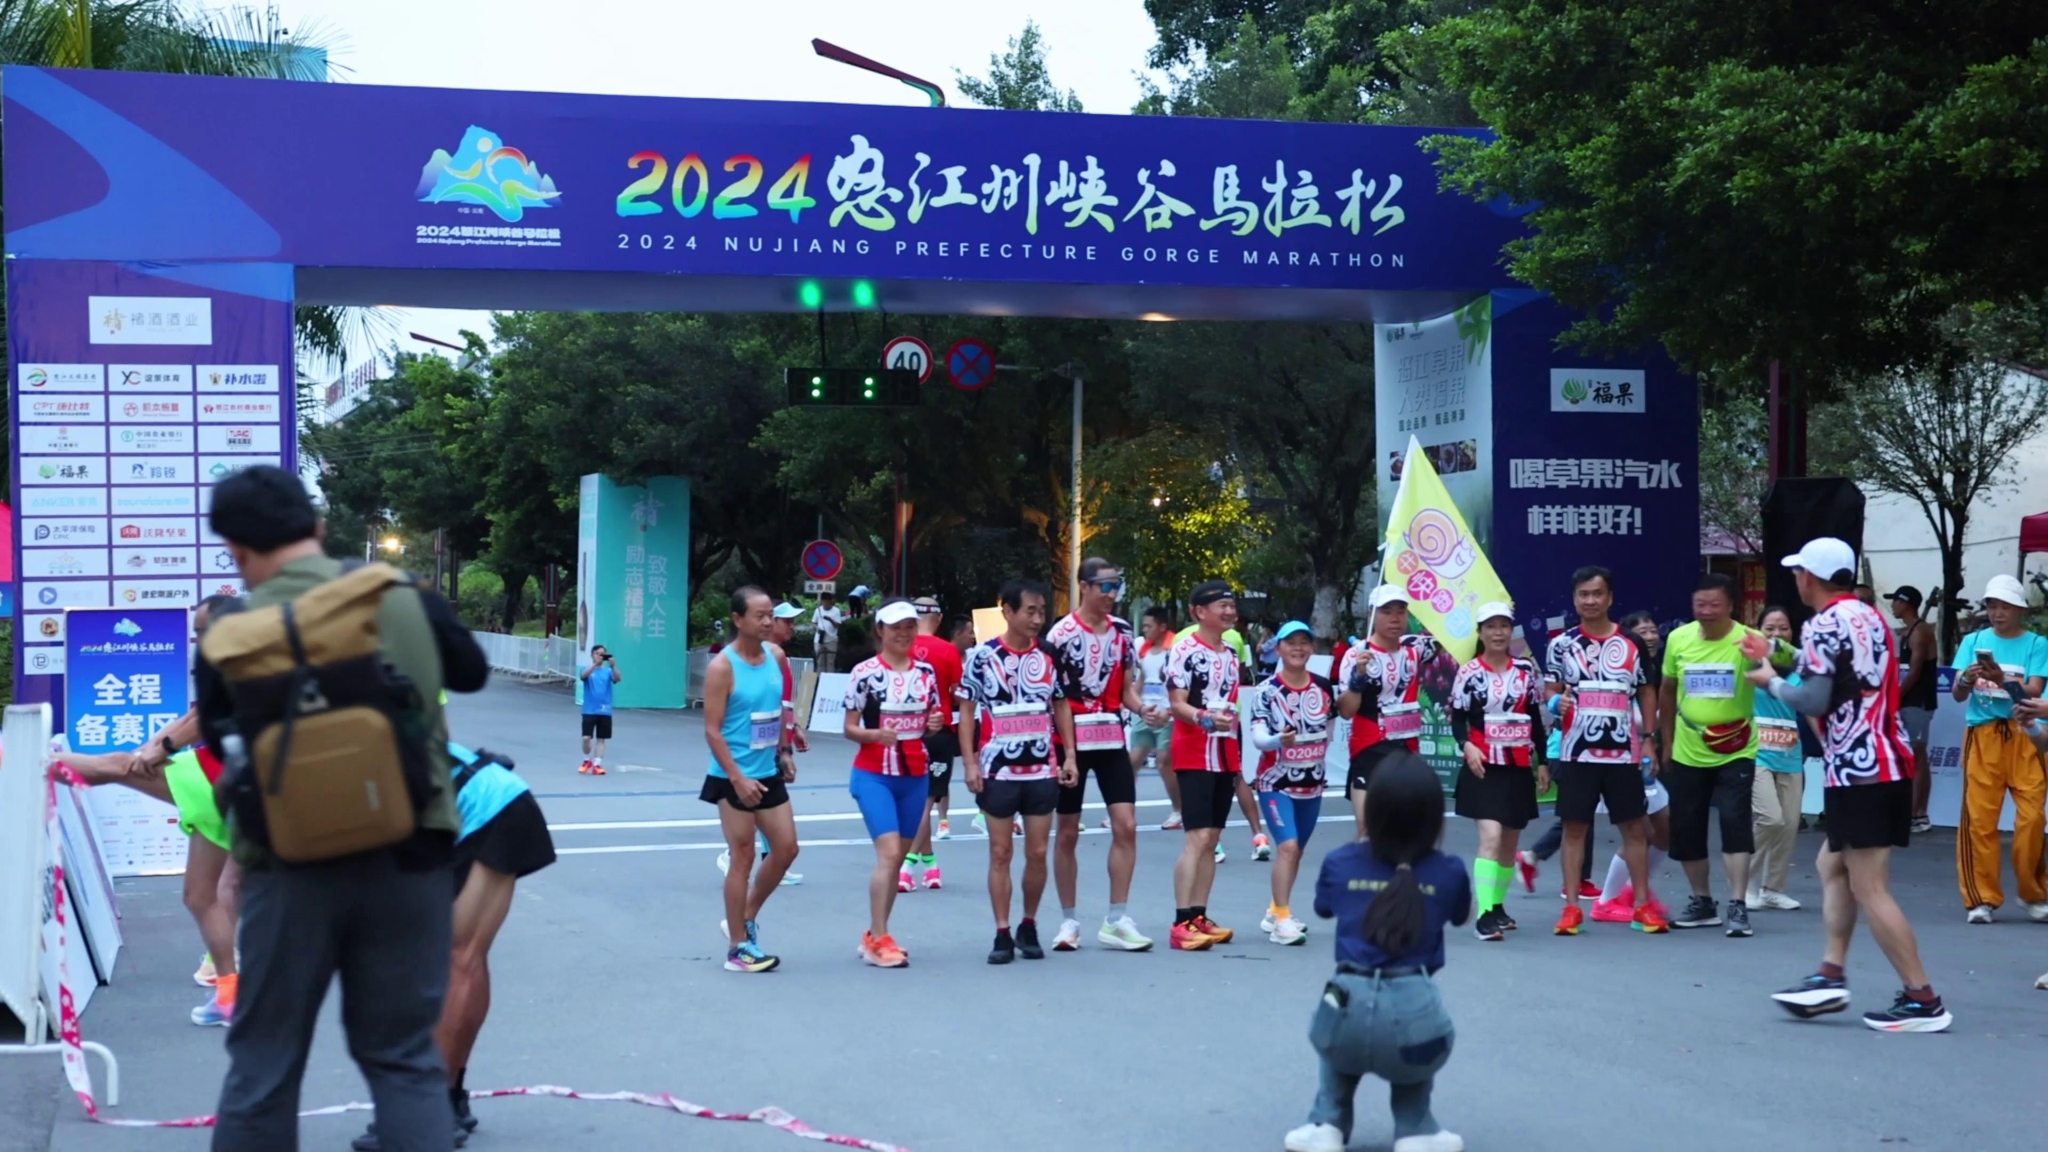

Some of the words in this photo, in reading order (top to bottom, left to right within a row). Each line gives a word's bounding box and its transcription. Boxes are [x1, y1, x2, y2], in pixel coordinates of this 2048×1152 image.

[618, 234, 698, 250] 2024
[724, 236, 870, 255] NUJIANG
[896, 241, 1098, 261] PREFECTURE
[1121, 247, 1220, 264] GORGE
[1243, 250, 1405, 267] MARATHON
[892, 351, 921, 373] 40
[1592, 381, 1635, 406] 福果
[60, 464, 89, 479] 福果
[1509, 458, 1683, 488] 喝草果汽水
[647, 555, 667, 637] 致敬人生
[93, 673, 162, 706] 全程
[1690, 677, 1728, 689] B1461
[1001, 718, 1042, 733] Q1199
[1489, 726, 1530, 738] Q2053
[1757, 730, 1793, 743] H1124
[1286, 745, 1326, 760] Q2048
